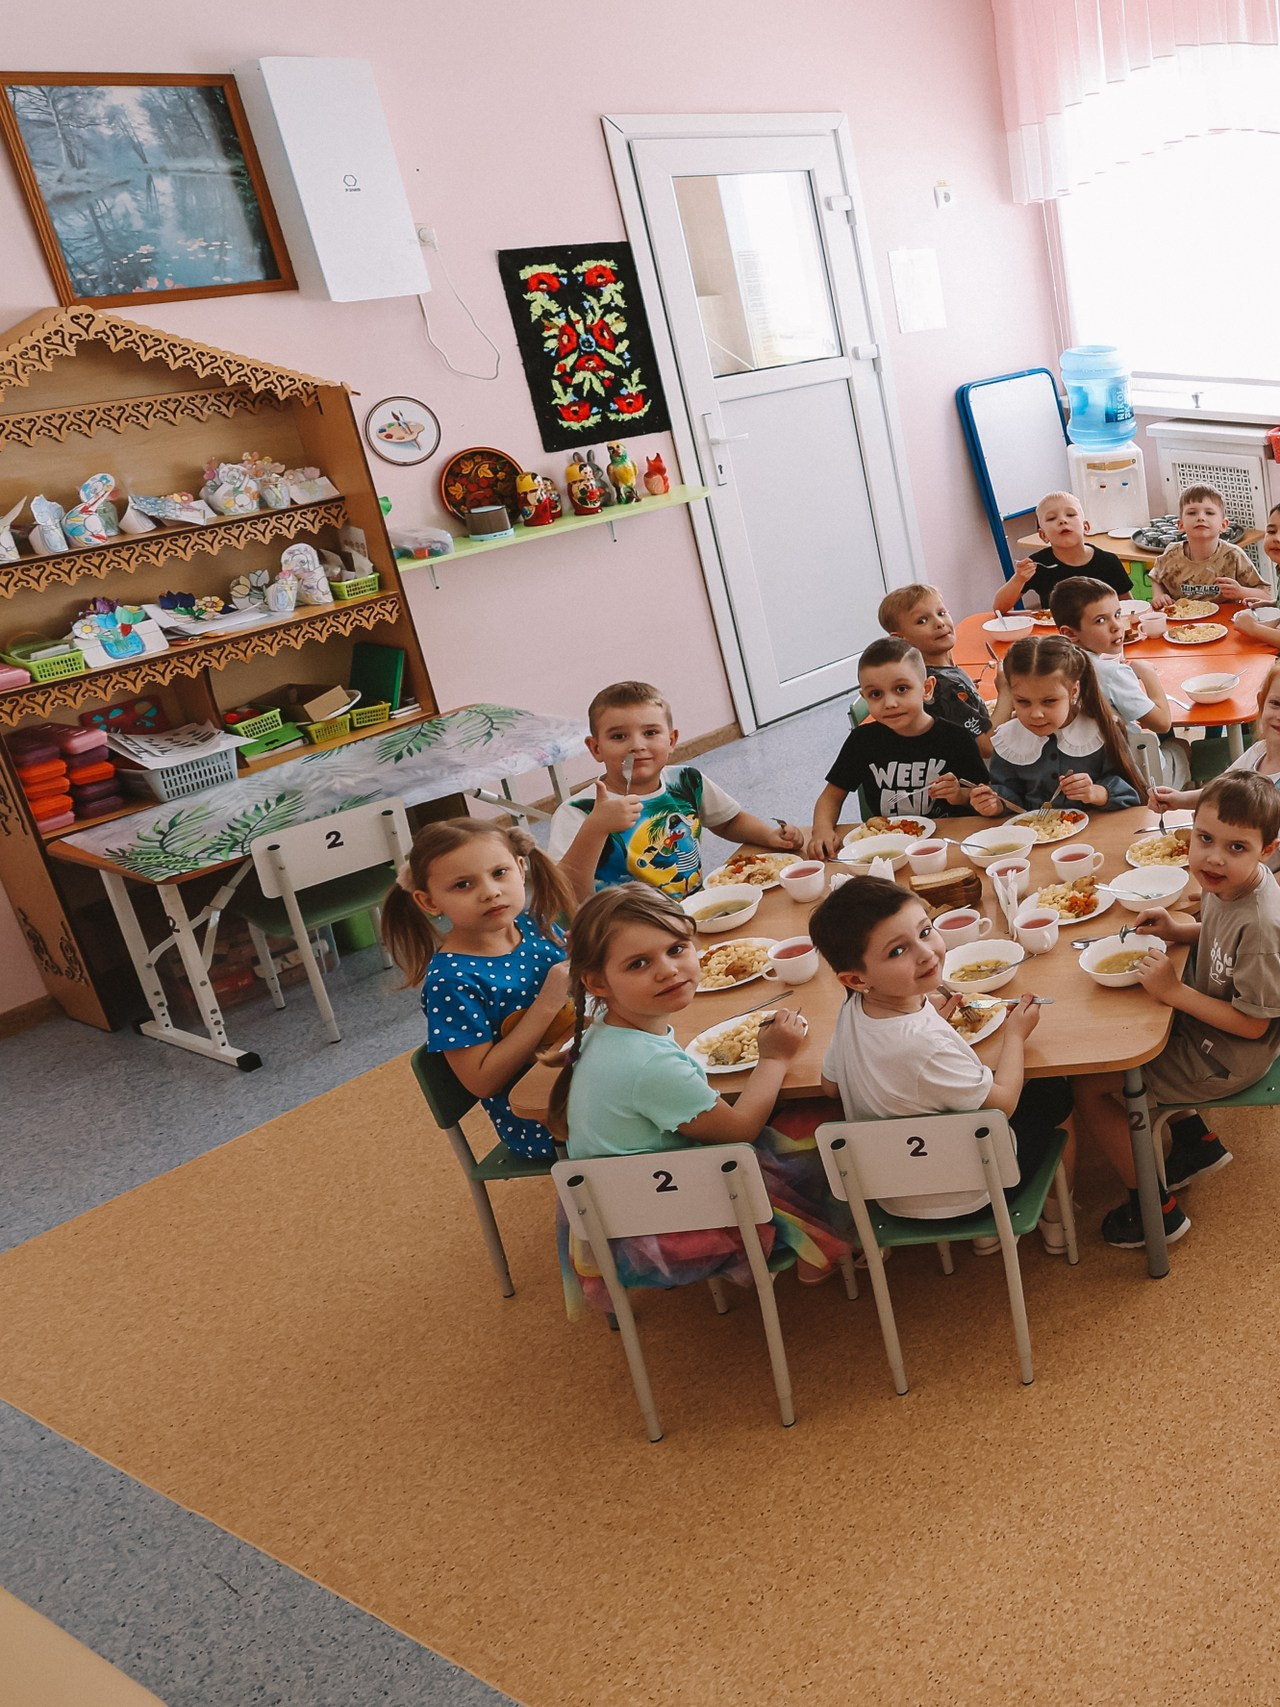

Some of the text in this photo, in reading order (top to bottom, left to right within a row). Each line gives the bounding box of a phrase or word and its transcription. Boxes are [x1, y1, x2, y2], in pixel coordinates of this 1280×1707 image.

[869, 758, 946, 789] WEEK
[326, 831, 344, 849] 2
[1129, 1111, 1147, 1131] 2
[907, 1136, 928, 1157] 2
[653, 1170, 678, 1192] 2
